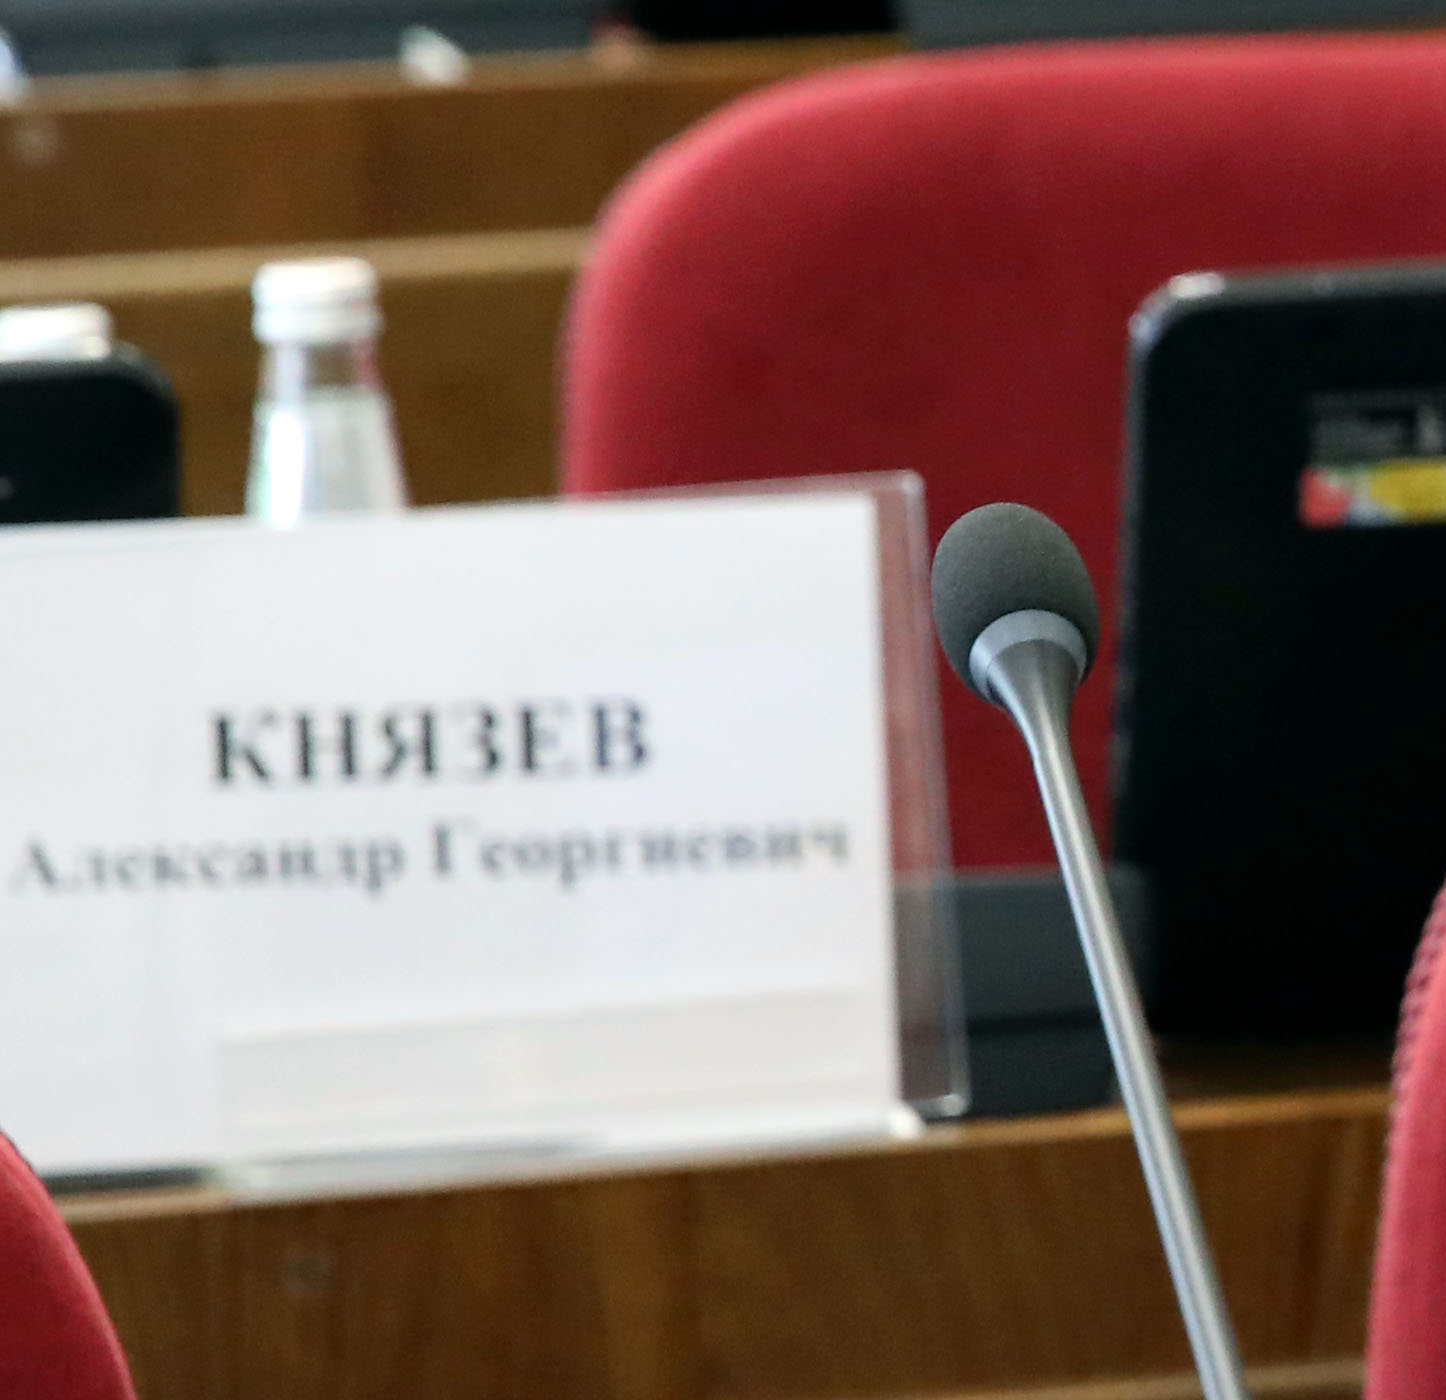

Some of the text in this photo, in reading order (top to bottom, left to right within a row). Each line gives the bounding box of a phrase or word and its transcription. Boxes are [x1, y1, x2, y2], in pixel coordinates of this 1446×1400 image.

[208, 696, 651, 789] КНЯЗЕВ
[10, 821, 851, 898] Александр Георгиевич
